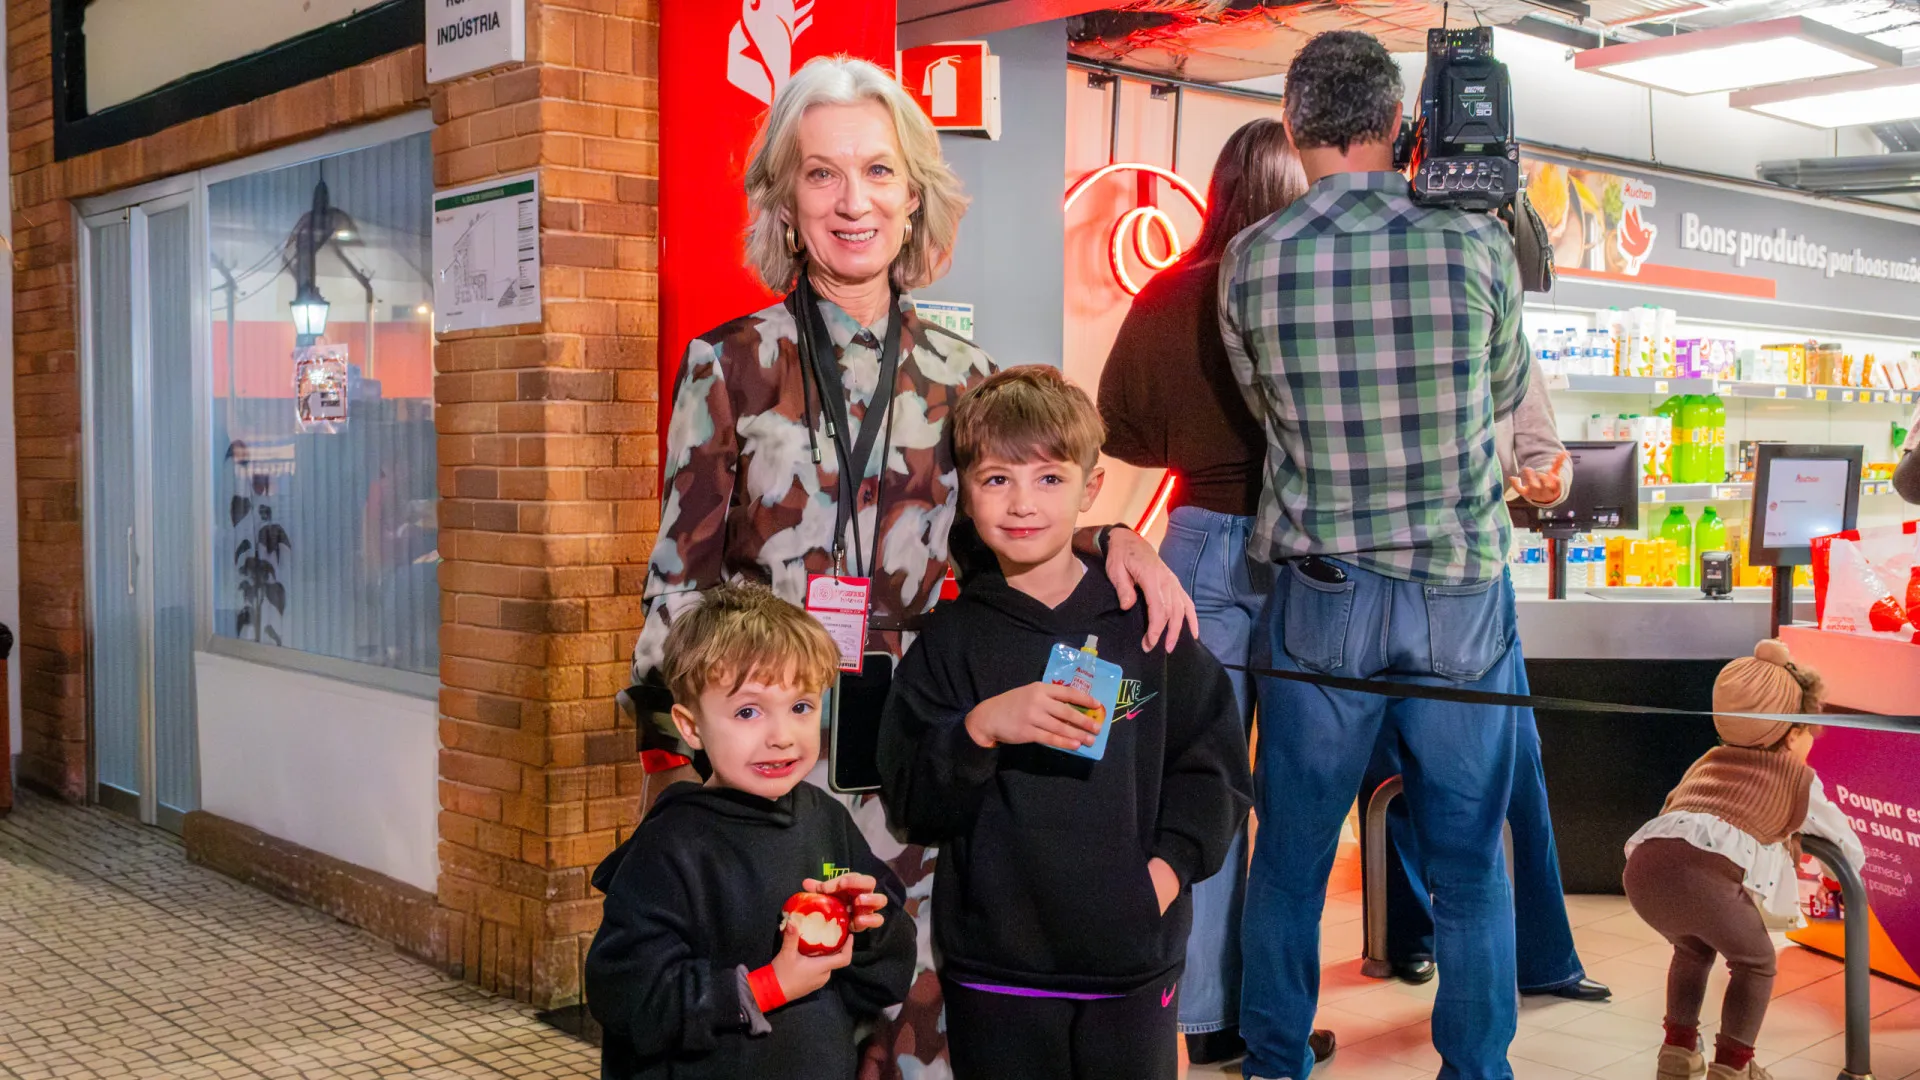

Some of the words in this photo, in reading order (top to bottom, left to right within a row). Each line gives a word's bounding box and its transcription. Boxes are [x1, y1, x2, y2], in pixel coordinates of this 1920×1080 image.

[437, 11, 500, 46] INDÚSTRIA
[1624, 183, 1653, 200] Auchan
[1680, 212, 1737, 256] Bons
[1737, 226, 1828, 268] produtos
[1826, 250, 1855, 278] por
[1853, 248, 1888, 277] boas
[1116, 679, 1142, 703] IKE
[1836, 784, 1902, 819] Poupar
[1870, 821, 1904, 843] sua
